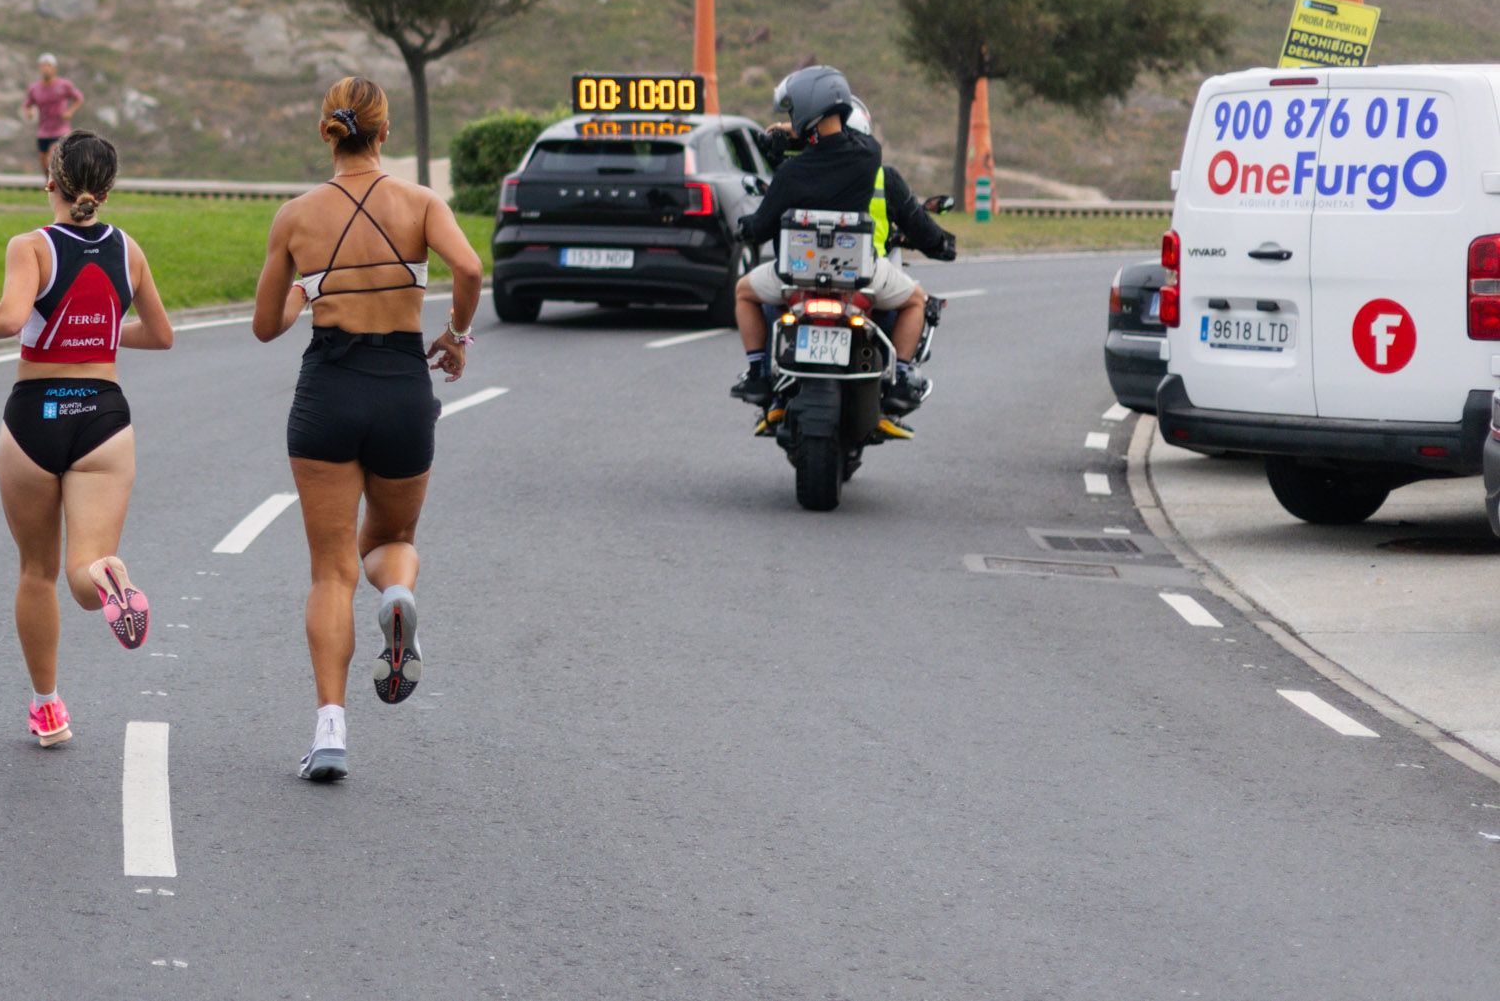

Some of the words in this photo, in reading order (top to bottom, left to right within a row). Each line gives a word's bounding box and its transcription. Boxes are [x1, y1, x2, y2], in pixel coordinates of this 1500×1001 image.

[1325, 18, 1368, 37] DEPORTIVA
[1291, 31, 1364, 57] PROHIBIDO
[1214, 99, 1273, 141] 900
[1284, 98, 1351, 139] 876
[1365, 97, 1439, 139] 016
[1207, 149, 1448, 211] OneFurgO
[1239, 199, 1276, 208] ALQUILER
[1280, 199, 1290, 208] DE
[1294, 199, 1355, 209] FURGONETAS
[1187, 247, 1226, 257] VIVARO
[1213, 320, 1252, 340] 9618
[1257, 322, 1289, 342] LTD
[59, 402, 82, 410] XUNTA
[68, 404, 97, 415] GALICIA
